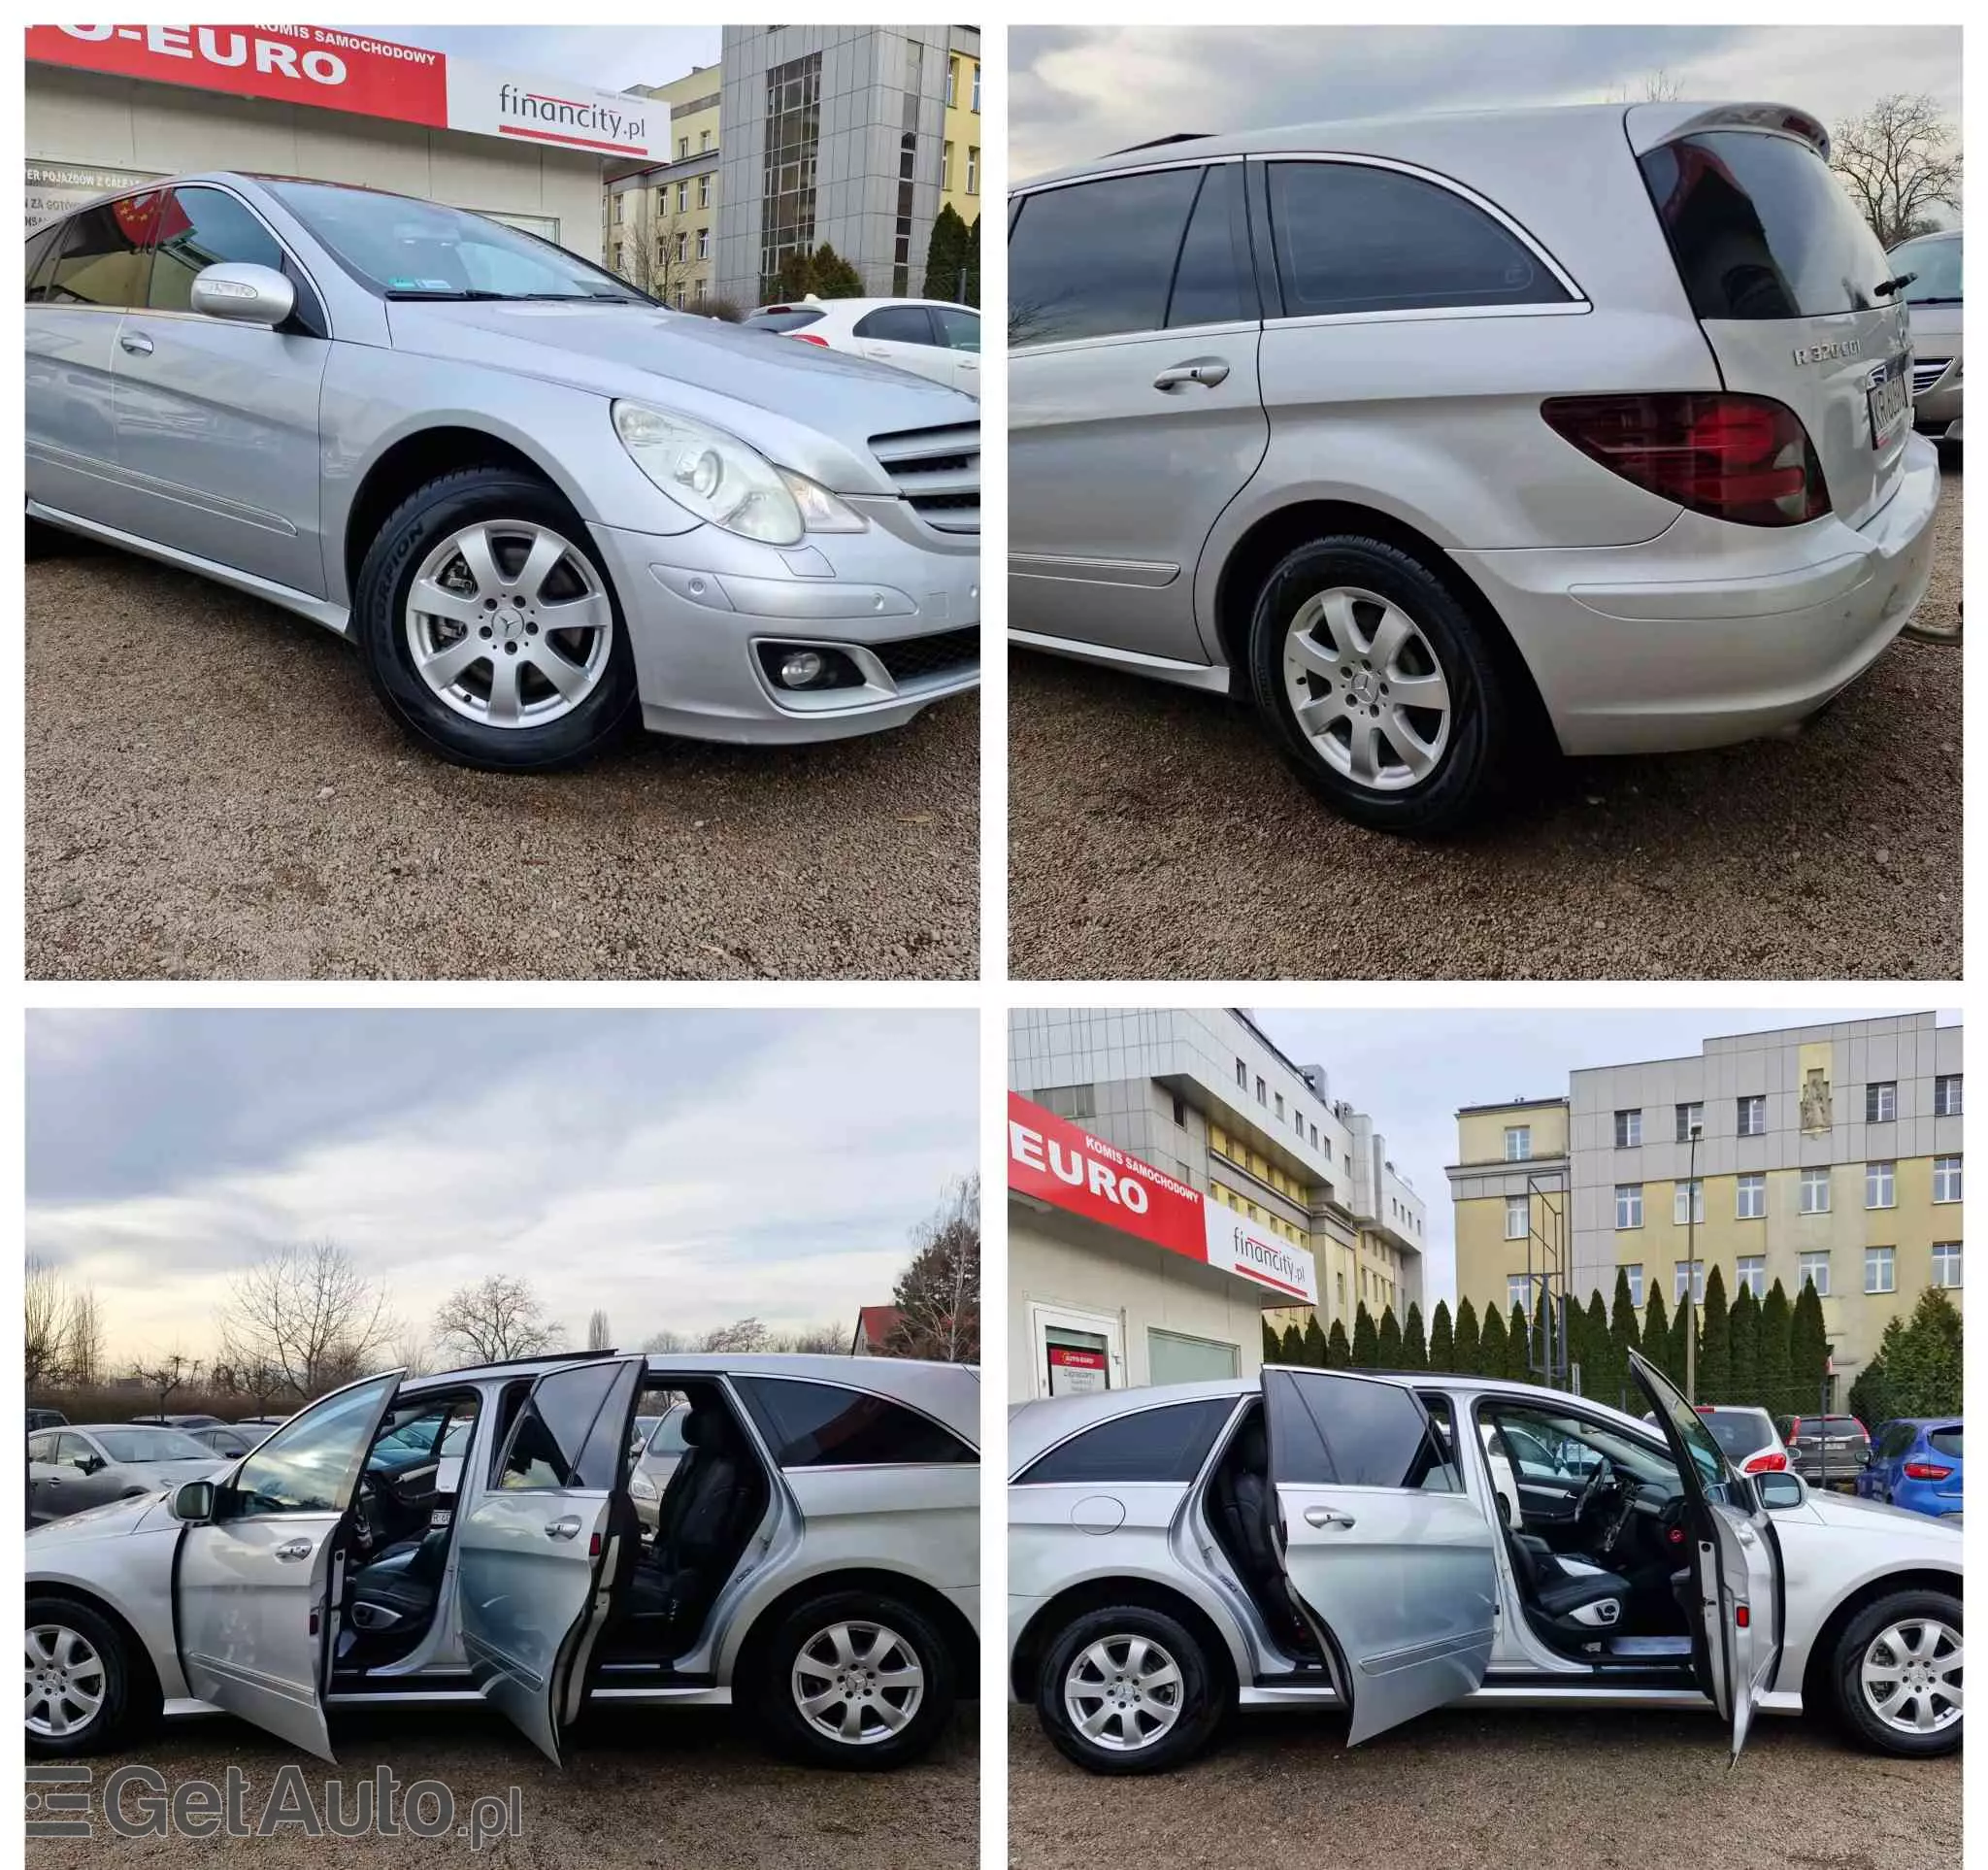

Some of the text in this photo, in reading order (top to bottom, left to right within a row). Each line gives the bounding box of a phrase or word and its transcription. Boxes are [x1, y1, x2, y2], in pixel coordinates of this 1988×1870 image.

[24, 24, 348, 84] O-EURO
[315, 30, 436, 65] SAMOCHODOWY
[499, 83, 646, 140] financity.pl
[1793, 349, 1806, 366] R
[1810, 342, 1838, 362] 320
[1009, 1119, 1148, 1214] EURO
[1085, 1135, 1199, 1204] KOMIS SAMOCHODOWY
[1233, 1226, 1306, 1284] financity.pl
